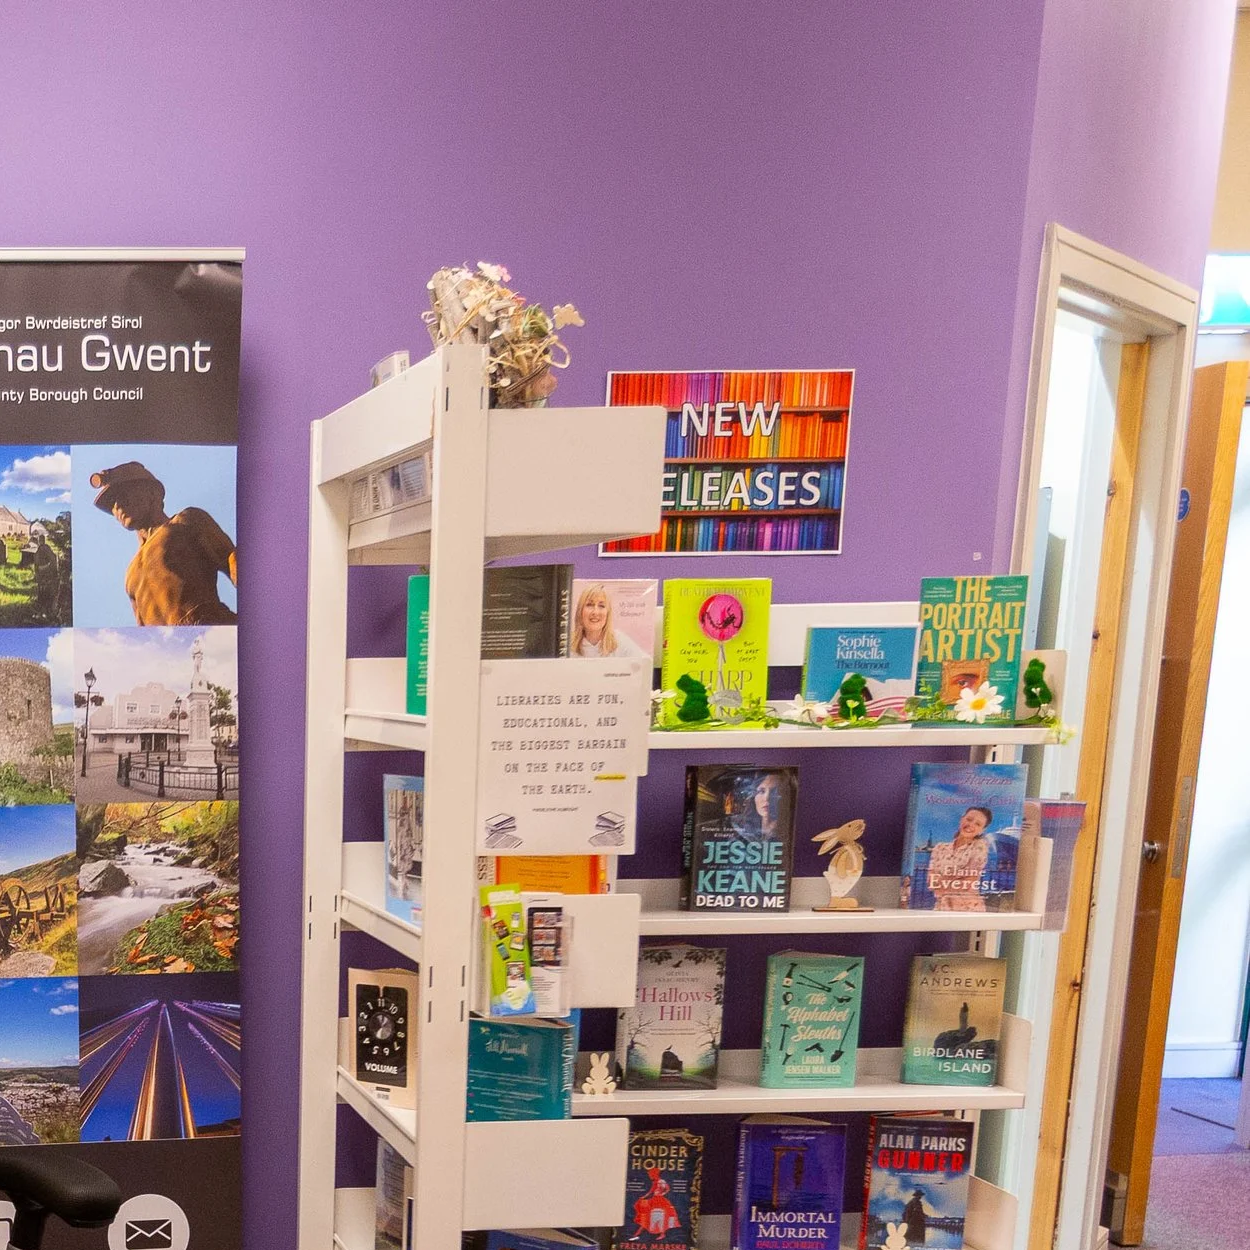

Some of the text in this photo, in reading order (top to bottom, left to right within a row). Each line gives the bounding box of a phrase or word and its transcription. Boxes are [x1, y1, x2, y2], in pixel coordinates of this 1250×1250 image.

[25, 316, 107, 330] Bwrdeistref
[111, 316, 142, 329] Sirol
[81, 334, 211, 373] Gwent
[30, 388, 87, 404] Borough
[93, 387, 143, 401] Council
[681, 402, 780, 437] NEW
[660, 471, 821, 507] ELEASES
[954, 577, 993, 602] THE
[560, 590, 569, 627] STEVE
[920, 602, 1026, 630] PORTRAIT
[837, 634, 881, 649] Sophie
[918, 629, 1021, 663] ARTIST
[836, 647, 884, 659] Kinsella
[836, 661, 851, 669] The
[687, 670, 752, 691] HARP
[496, 695, 562, 706] LIBRARIES
[568, 695, 590, 705] ARE
[503, 717, 618, 729] EDUCATIONAL, AND
[491, 739, 627, 751] THE BIGGEST BARGAIN
[504, 762, 605, 773] ON THE FACE OF
[521, 784, 593, 795] THE EARTH.
[703, 841, 783, 865] JESSIE
[943, 865, 985, 877] Elaine
[698, 870, 786, 894] KEANE
[928, 873, 997, 890] Everest
[696, 895, 784, 908] DEAD TO ME
[920, 977, 998, 988] ANDREWS
[641, 987, 713, 1003] Hallows
[389, 1003, 398, 1014] 10
[659, 1006, 692, 1021] Hill
[787, 1007, 849, 1023] Alphabet
[791, 1025, 841, 1042] Sleuths
[913, 1047, 985, 1059] BIRDLANE
[364, 1062, 398, 1074] VOLUME
[938, 1062, 991, 1073] ISLAND
[879, 1133, 966, 1151] ALAN PARKS
[631, 1145, 688, 1158] CINDER
[631, 1159, 686, 1171] HOUSE
[878, 1149, 965, 1172] GUNNER
